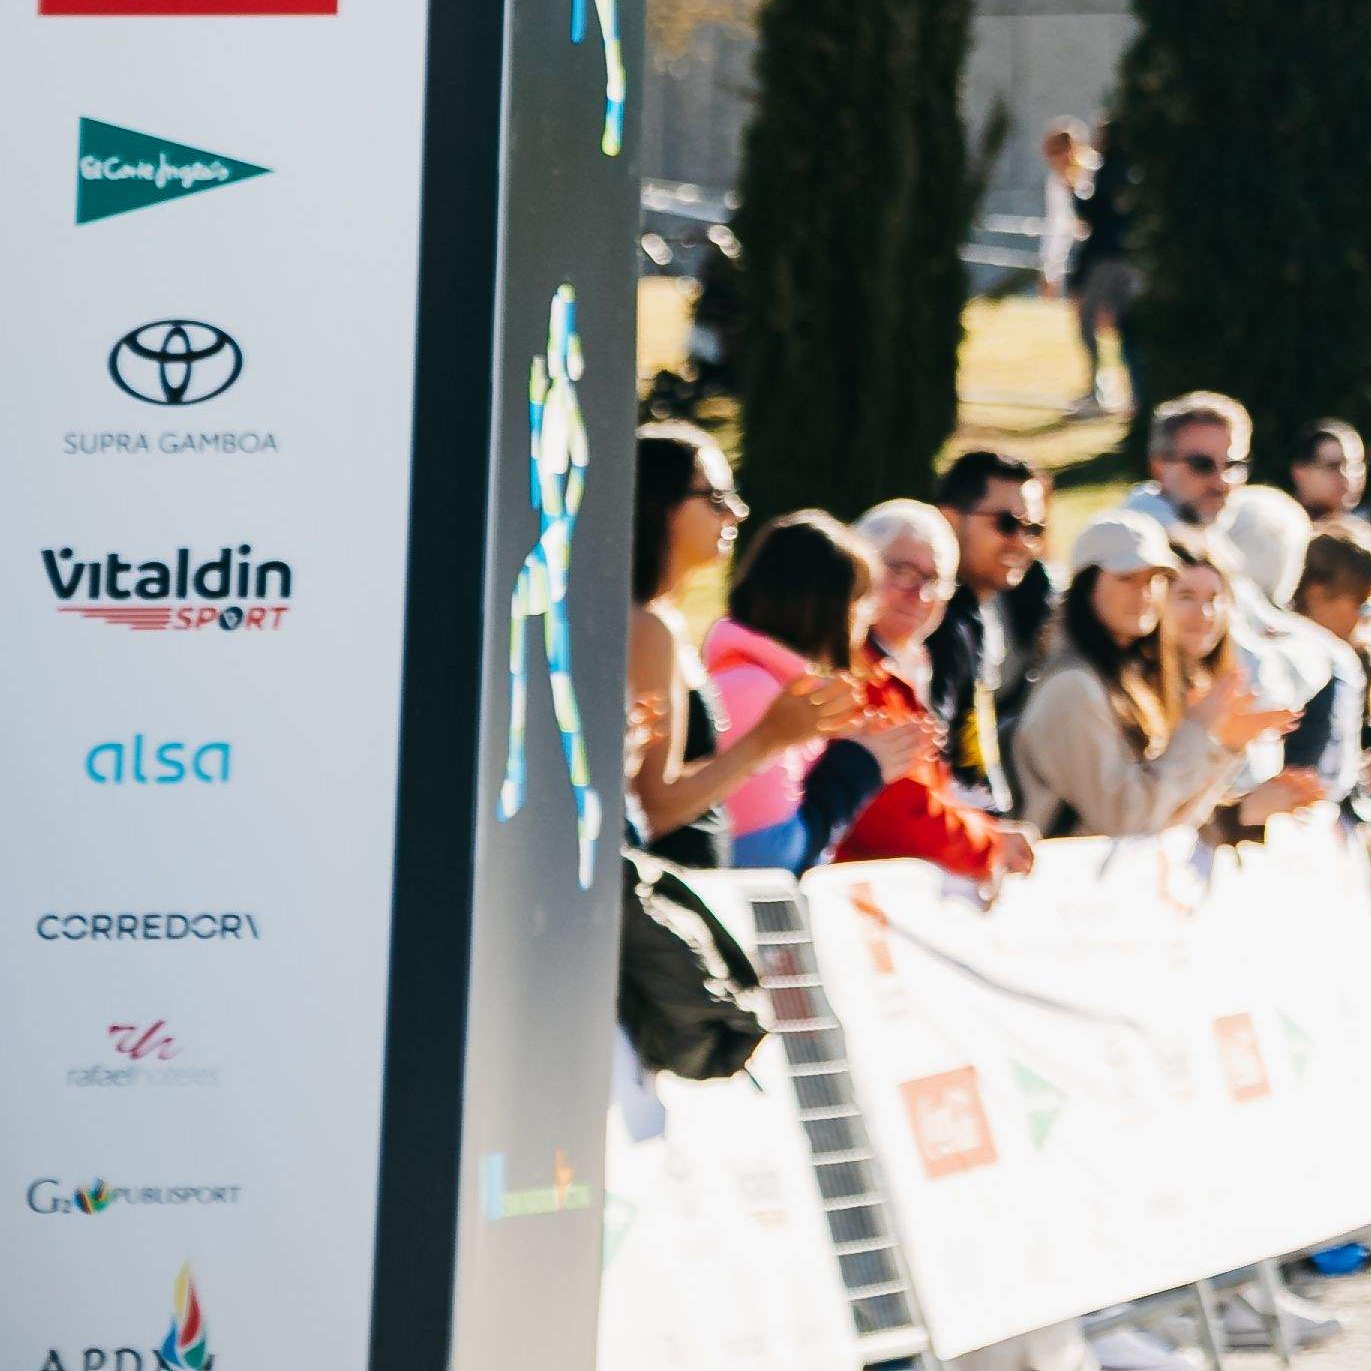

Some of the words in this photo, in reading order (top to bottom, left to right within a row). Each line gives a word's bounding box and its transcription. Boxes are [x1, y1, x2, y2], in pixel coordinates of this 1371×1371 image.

[63, 431, 150, 455] SUPRA
[158, 431, 279, 455] GAMBOA
[41, 543, 292, 602] Vitaldin
[174, 605, 289, 632] SPORT
[85, 733, 232, 784] alsa
